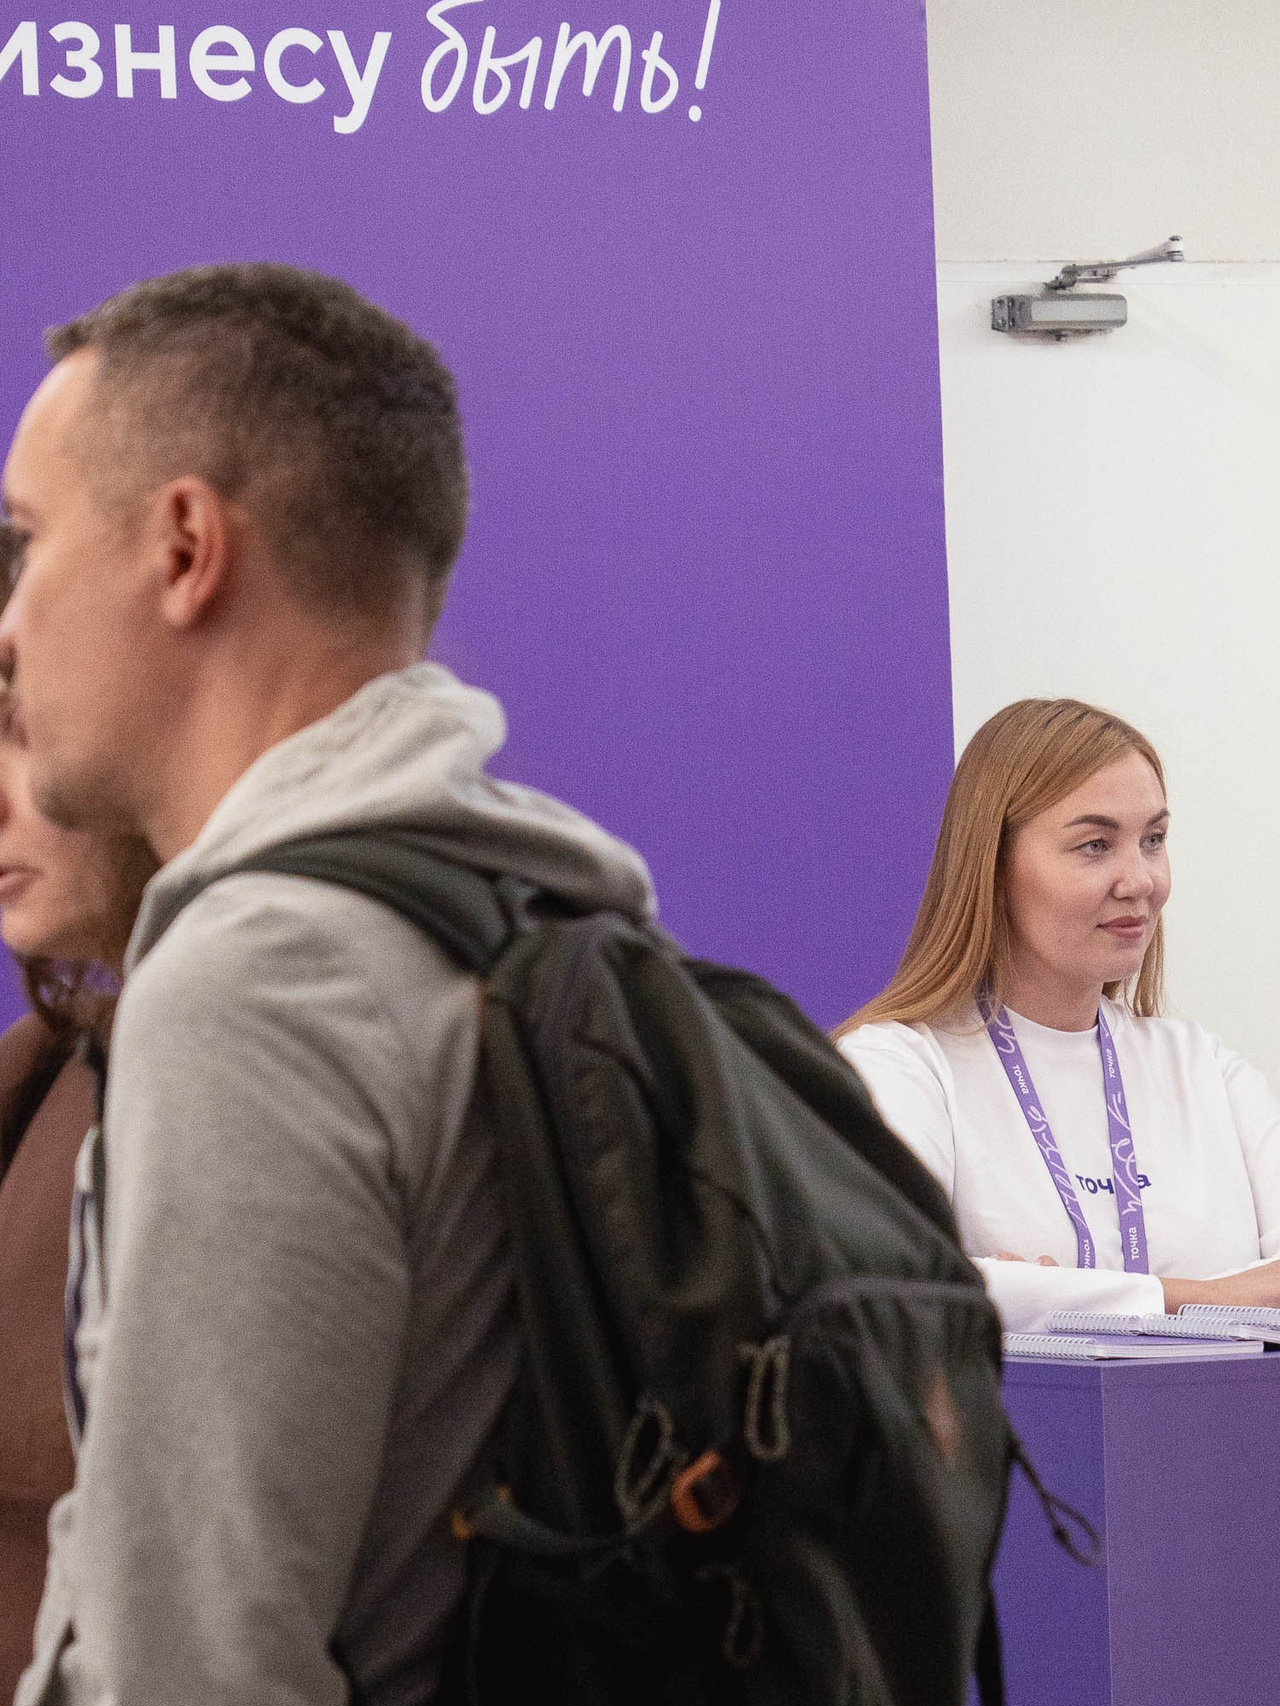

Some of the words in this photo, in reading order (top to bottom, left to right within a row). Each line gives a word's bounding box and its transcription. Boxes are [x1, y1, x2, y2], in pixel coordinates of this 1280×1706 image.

[420, 0, 722, 122] быть!
[1012, 1063, 1029, 1095] точка
[1107, 1048, 1117, 1079] точка
[1075, 1174, 1152, 1195] точа
[1128, 1226, 1140, 1261] точка
